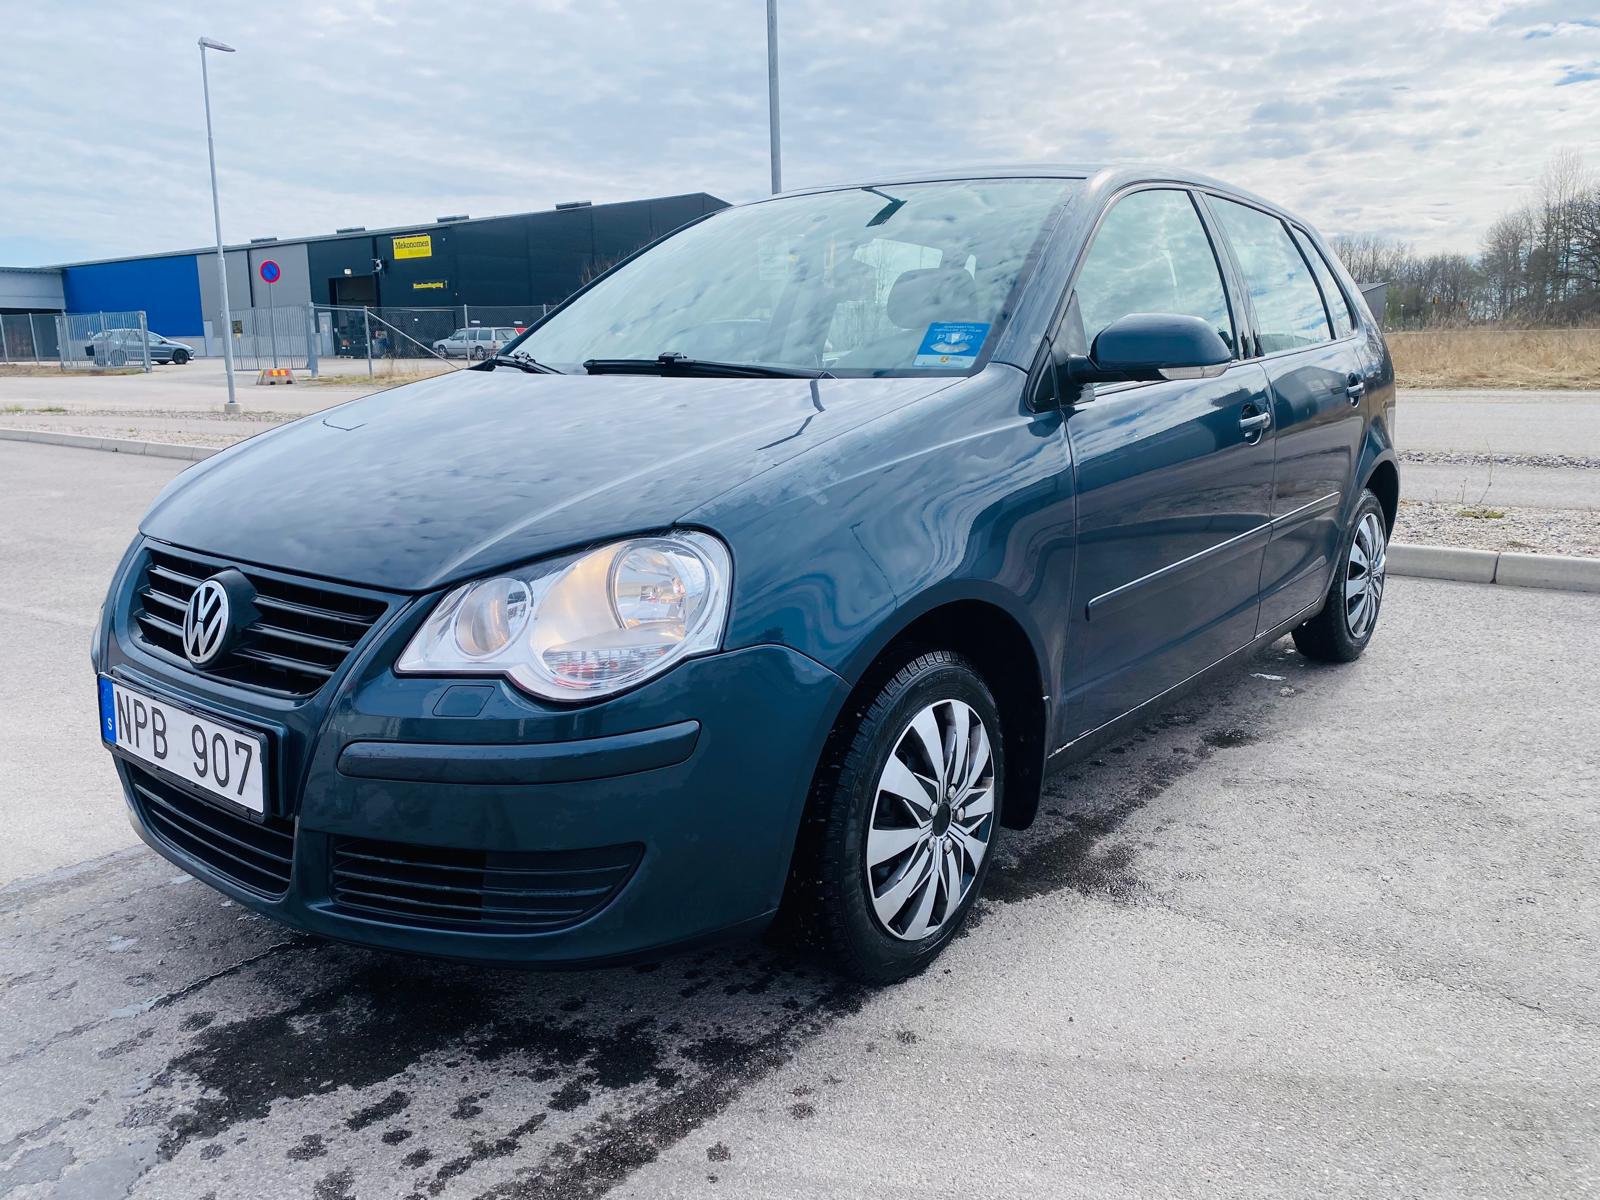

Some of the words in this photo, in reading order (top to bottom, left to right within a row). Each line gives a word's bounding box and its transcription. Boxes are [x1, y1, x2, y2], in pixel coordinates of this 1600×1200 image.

[395, 241, 429, 249] Mekonomen
[107, 717, 113, 731] S
[116, 691, 168, 760] NPB
[191, 724, 253, 796] 907
